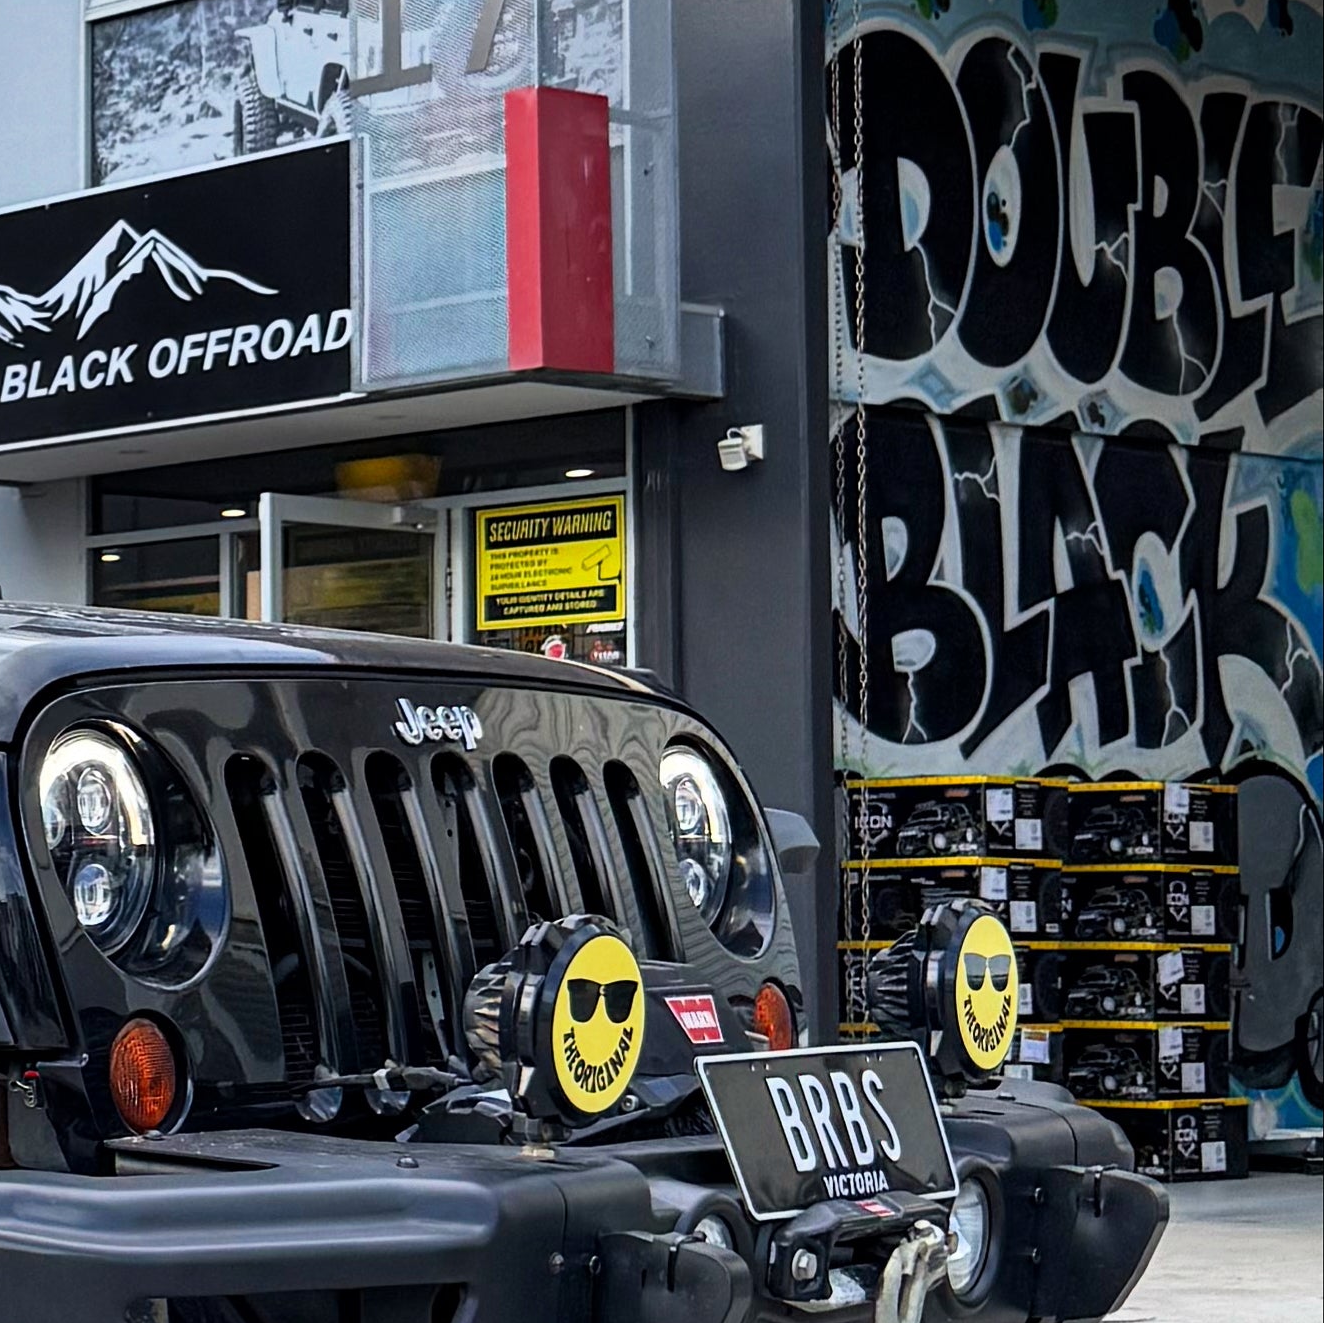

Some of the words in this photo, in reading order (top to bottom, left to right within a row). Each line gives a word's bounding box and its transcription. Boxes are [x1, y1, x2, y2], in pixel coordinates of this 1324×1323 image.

[0, 342, 135, 404] BLACK
[147, 307, 354, 380] OFFROAD
[489, 516, 551, 543] SECURITY
[552, 510, 613, 537] WARNING
[829, 396, 1324, 768] BLACK
[393, 697, 484, 750] Jeep
[765, 1069, 902, 1173] BRBS
[822, 1169, 890, 1199] VICTORIA
